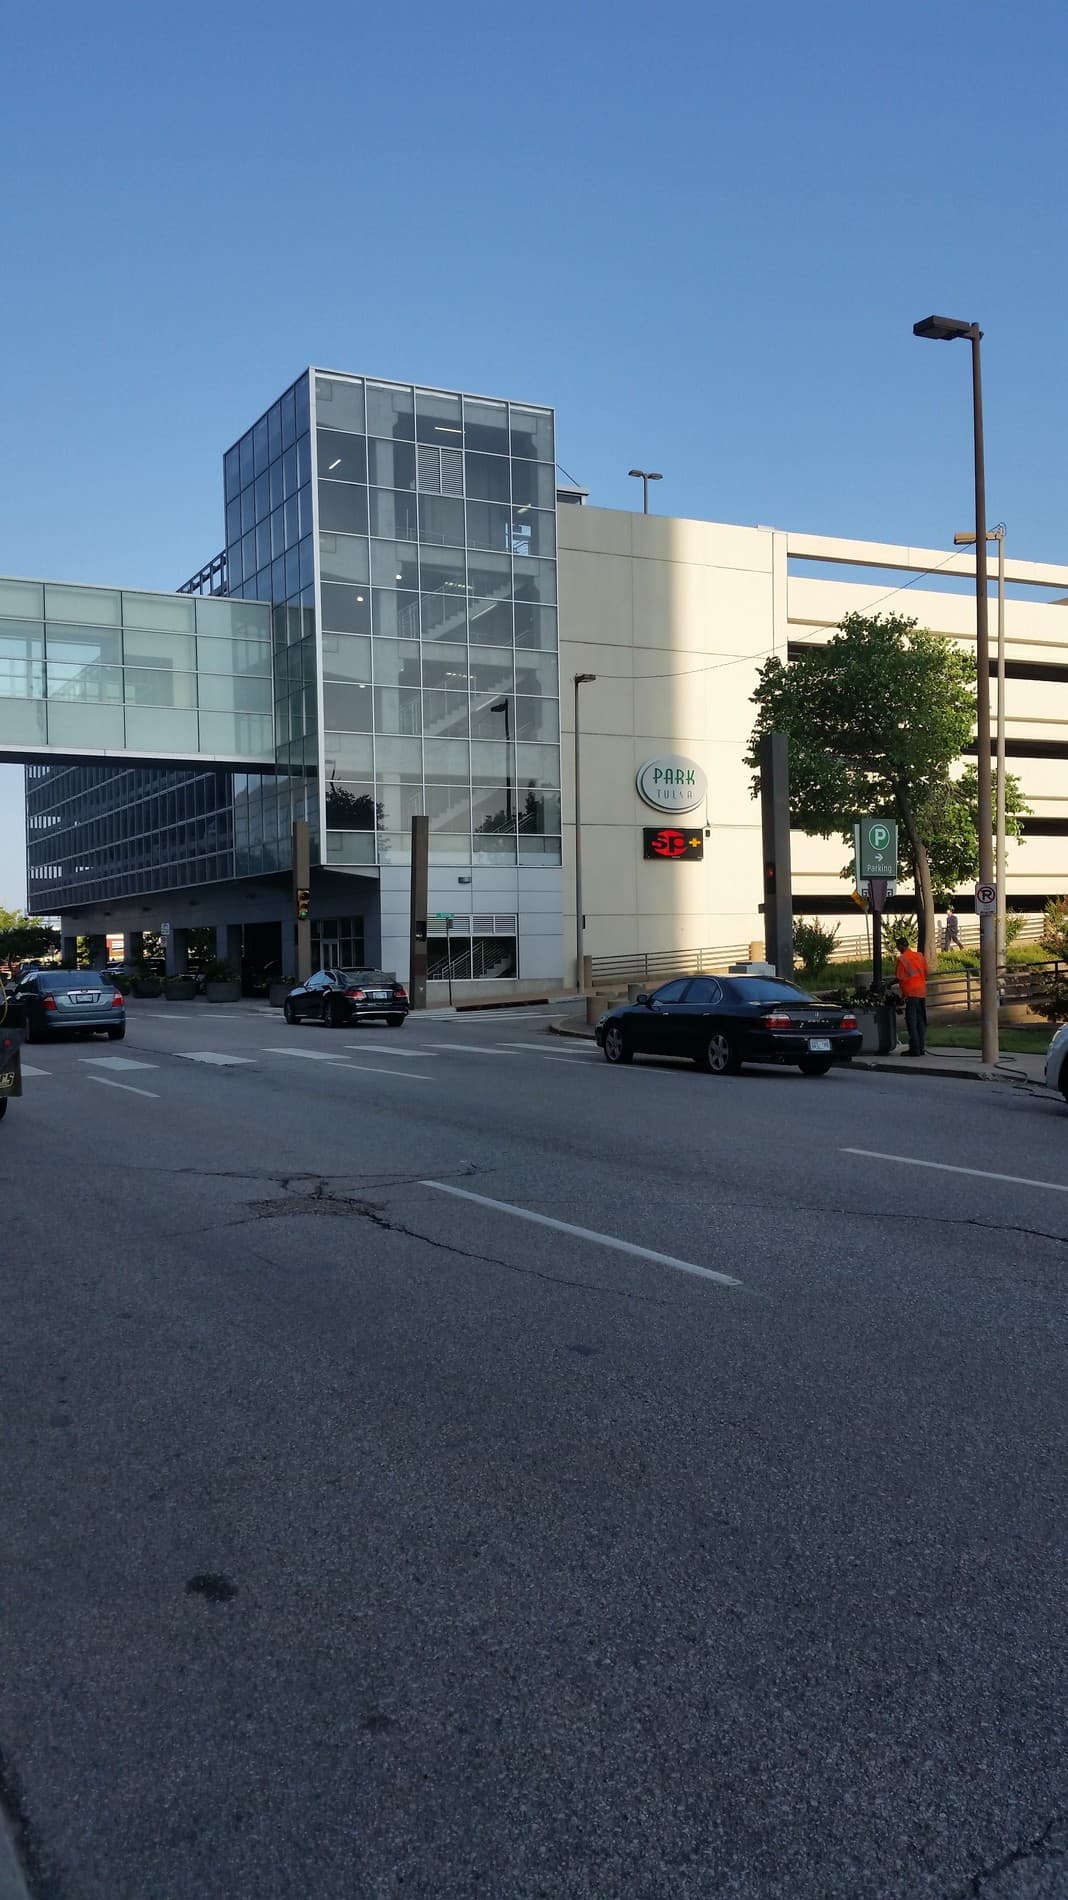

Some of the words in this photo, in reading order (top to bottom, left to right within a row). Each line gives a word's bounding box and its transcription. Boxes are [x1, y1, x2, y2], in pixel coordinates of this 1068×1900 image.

[653, 767, 696, 785] PARK
[656, 788, 694, 800] TULSA
[874, 828, 886, 846] P
[866, 863, 893, 875] Parking
